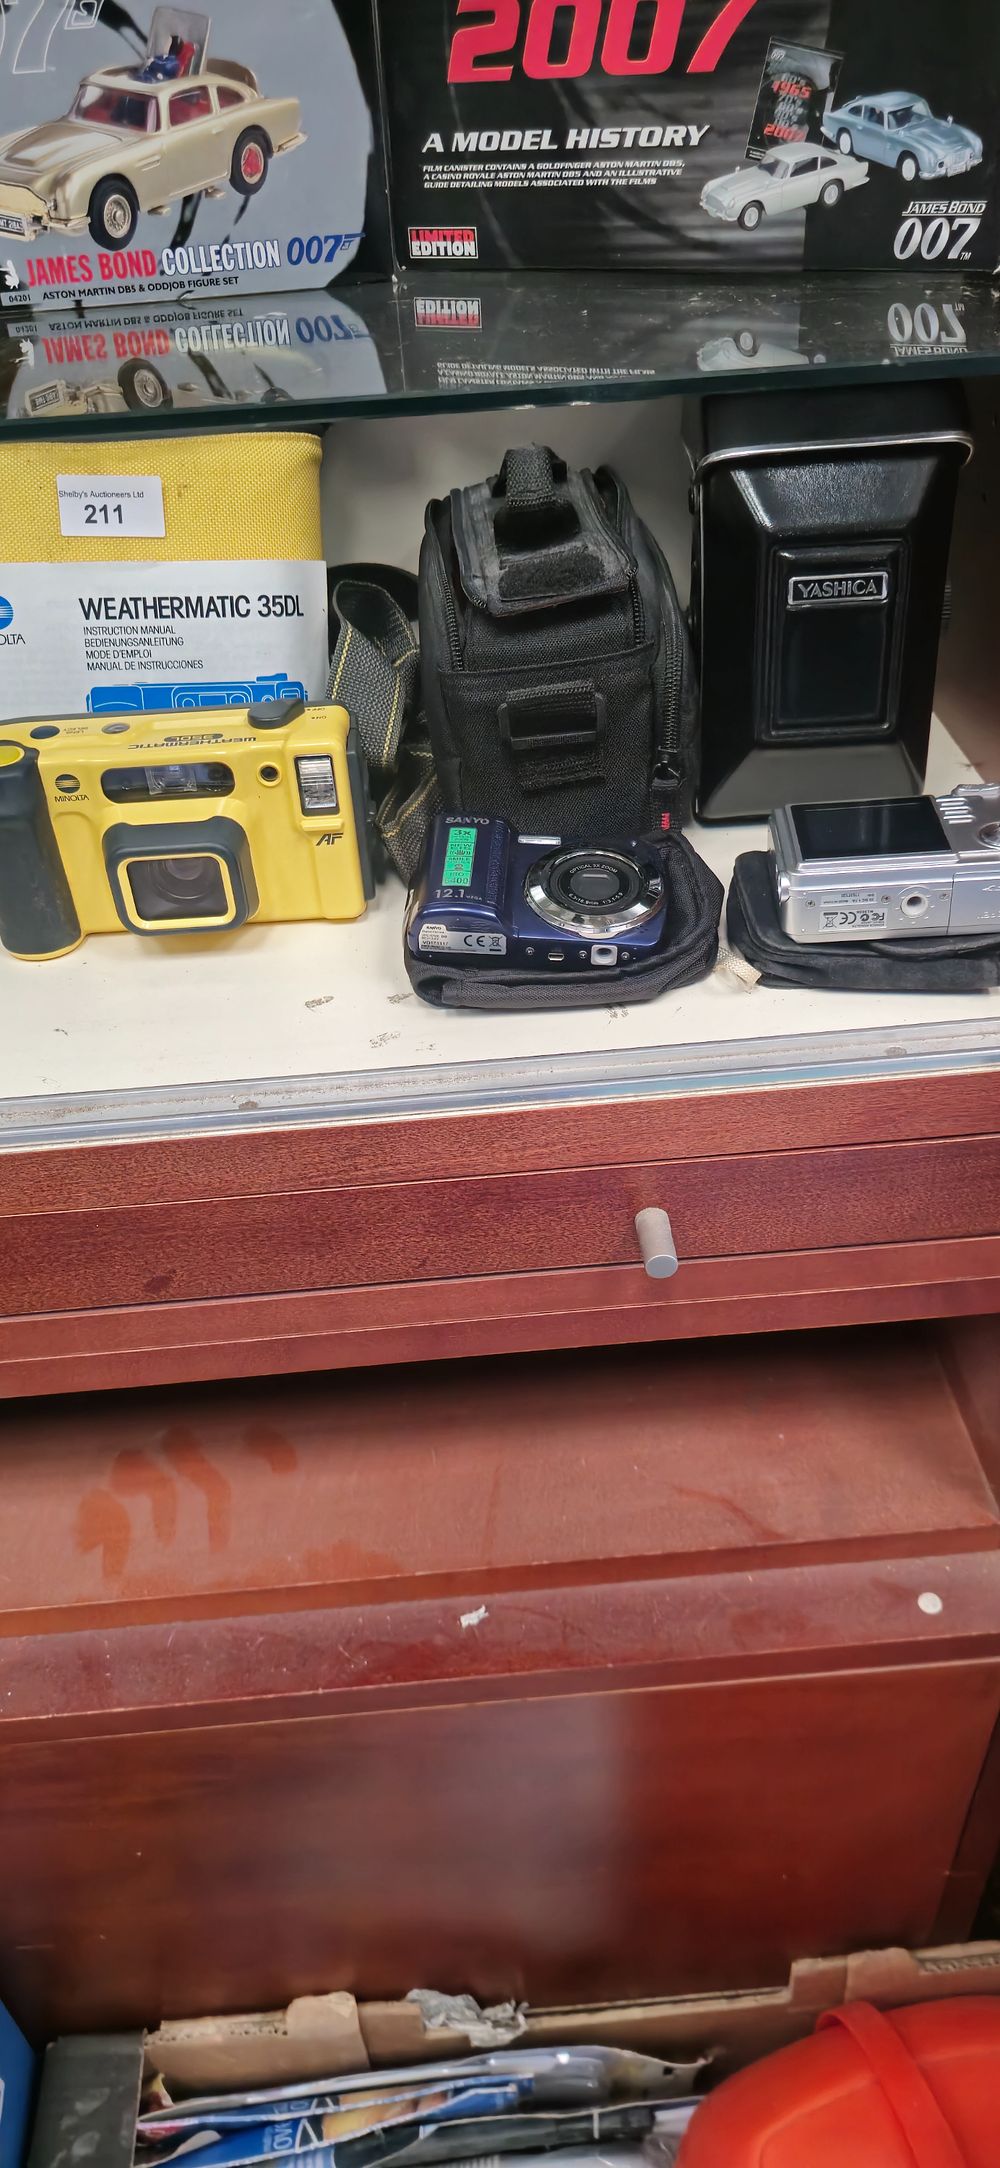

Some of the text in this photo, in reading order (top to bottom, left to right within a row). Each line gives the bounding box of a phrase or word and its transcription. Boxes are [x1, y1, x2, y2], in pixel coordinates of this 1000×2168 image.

[447, 0, 757, 84] 2007
[772, 80, 811, 99] 1965
[422, 124, 711, 153] A MODEL HISTORY
[423, 164, 442, 173] FILM
[443, 163, 484, 172] CANISTER
[485, 162, 527, 171] CONTAINS
[537, 161, 592, 170] GOLDFINGER
[593, 160, 624, 169] ASTON
[625, 160, 662, 169] MARTIN
[496, 171, 526, 179] ASTON
[603, 169, 617, 177] AN
[618, 168, 683, 176] ILLUSTRATIVE
[424, 177, 657, 189] GUIDE DETAILING MODELS ASSOCIATED WITH THE FILMS
[902, 200, 988, 214] JAMES BOND
[410, 229, 475, 242] LIMITED
[894, 217, 981, 260] 007
[411, 241, 476, 256] EDITION
[25, 234, 346, 288] JAMES BOND COLLECTION 007
[43, 276, 239, 301] ASTON MARTIN DB5 & ODDJOB FIGURE SET
[8, 294, 31, 303] 04201
[58, 490, 88, 499] Shelby's
[90, 490, 131, 498] Auctioneers
[84, 504, 123, 524] 211
[797, 579, 877, 598] YASHICA
[78, 594, 304, 620] WEATHERMATIC 35DL
[83, 625, 176, 636] INSTRUCTION MANUAL
[84, 637, 184, 648] BEDIENUNGSANLEITUNG
[85, 649, 152, 659] MODE D'EMPLOI
[87, 659, 203, 671] MANUAL DE INSTRUCCIONES
[54, 794, 90, 803] MINOLTA
[445, 817, 490, 825] SANYO
[315, 832, 344, 846] AF
[569, 863, 592, 874] OPTICAL
[601, 864, 618, 874] ZOOM
[435, 888, 465, 899] 12.1
